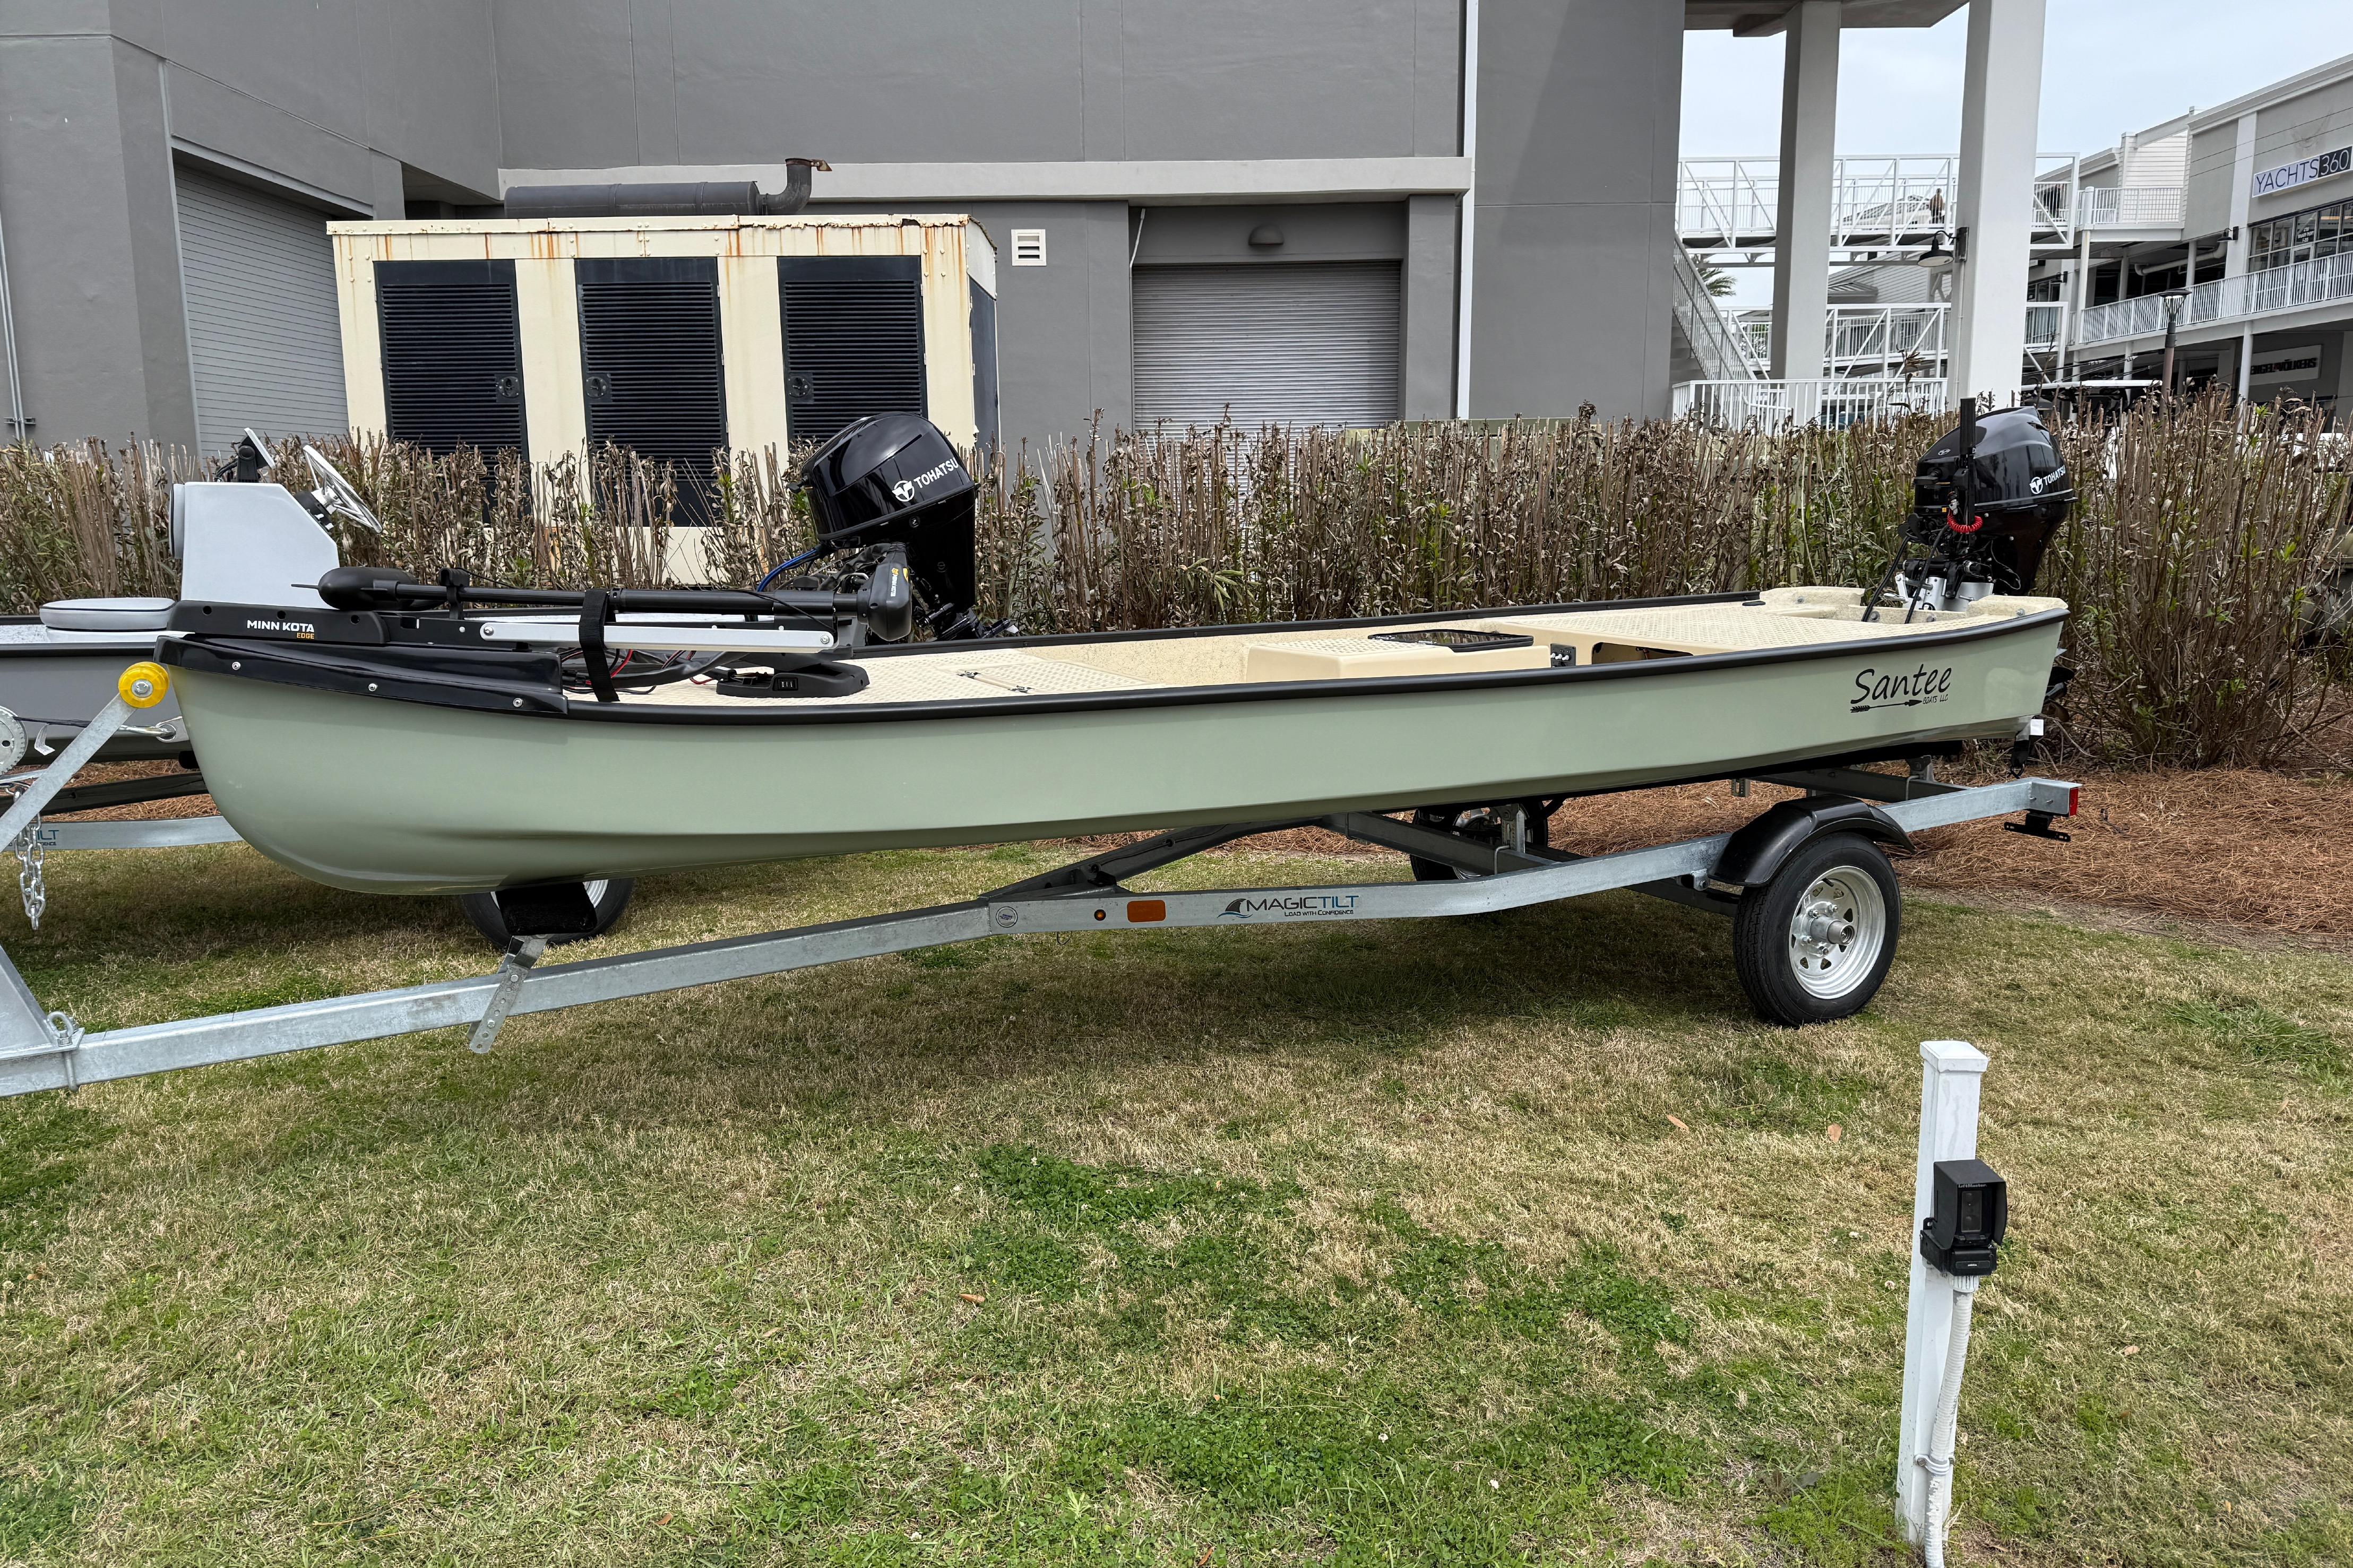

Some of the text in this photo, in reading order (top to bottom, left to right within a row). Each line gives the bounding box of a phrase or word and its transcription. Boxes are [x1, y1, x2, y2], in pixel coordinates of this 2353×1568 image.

[913, 457, 959, 488] TOHATSU
[2043, 464, 2066, 486] TOHATSU
[247, 620, 314, 633] MINN KOTA
[1850, 664, 1952, 704] Santee
[1923, 696, 1937, 704] BOATS
[1247, 895, 1359, 912] MAGICTILT
